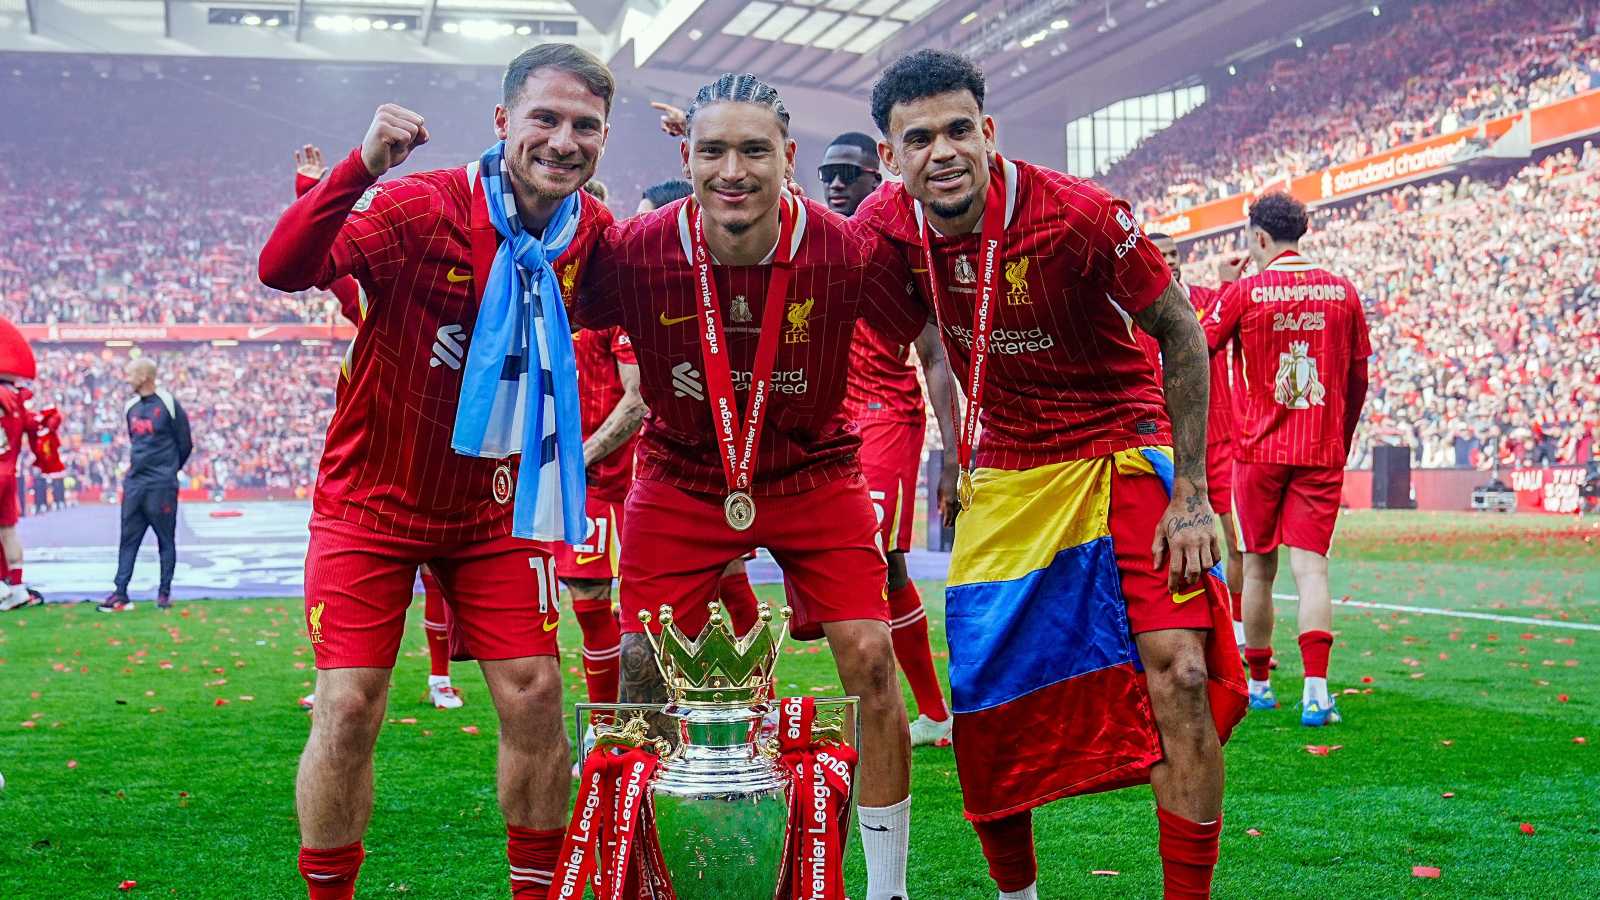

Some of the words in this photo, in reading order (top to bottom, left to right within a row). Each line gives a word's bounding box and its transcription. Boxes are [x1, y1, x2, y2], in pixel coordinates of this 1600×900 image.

[983, 239, 997, 285] Premier
[699, 263, 711, 308] Premier
[705, 309, 718, 354] League
[979, 286, 992, 331] League
[1251, 285, 1346, 303] CHAMPIONS
[951, 325, 1043, 340] stadard
[1272, 312, 1326, 331] 24/25
[959, 334, 1054, 355] chrtered
[973, 353, 984, 398] Premier
[719, 397, 732, 442] League
[740, 426, 756, 470] Premier
[748, 380, 765, 424] League
[573, 516, 608, 553] 21
[528, 555, 560, 613] 10
[808, 763, 831, 834] League
[557, 845, 585, 900] remier
[572, 772, 600, 843] League
[611, 835, 628, 900] remier
[620, 761, 645, 832] League
[808, 838, 826, 900] remier
